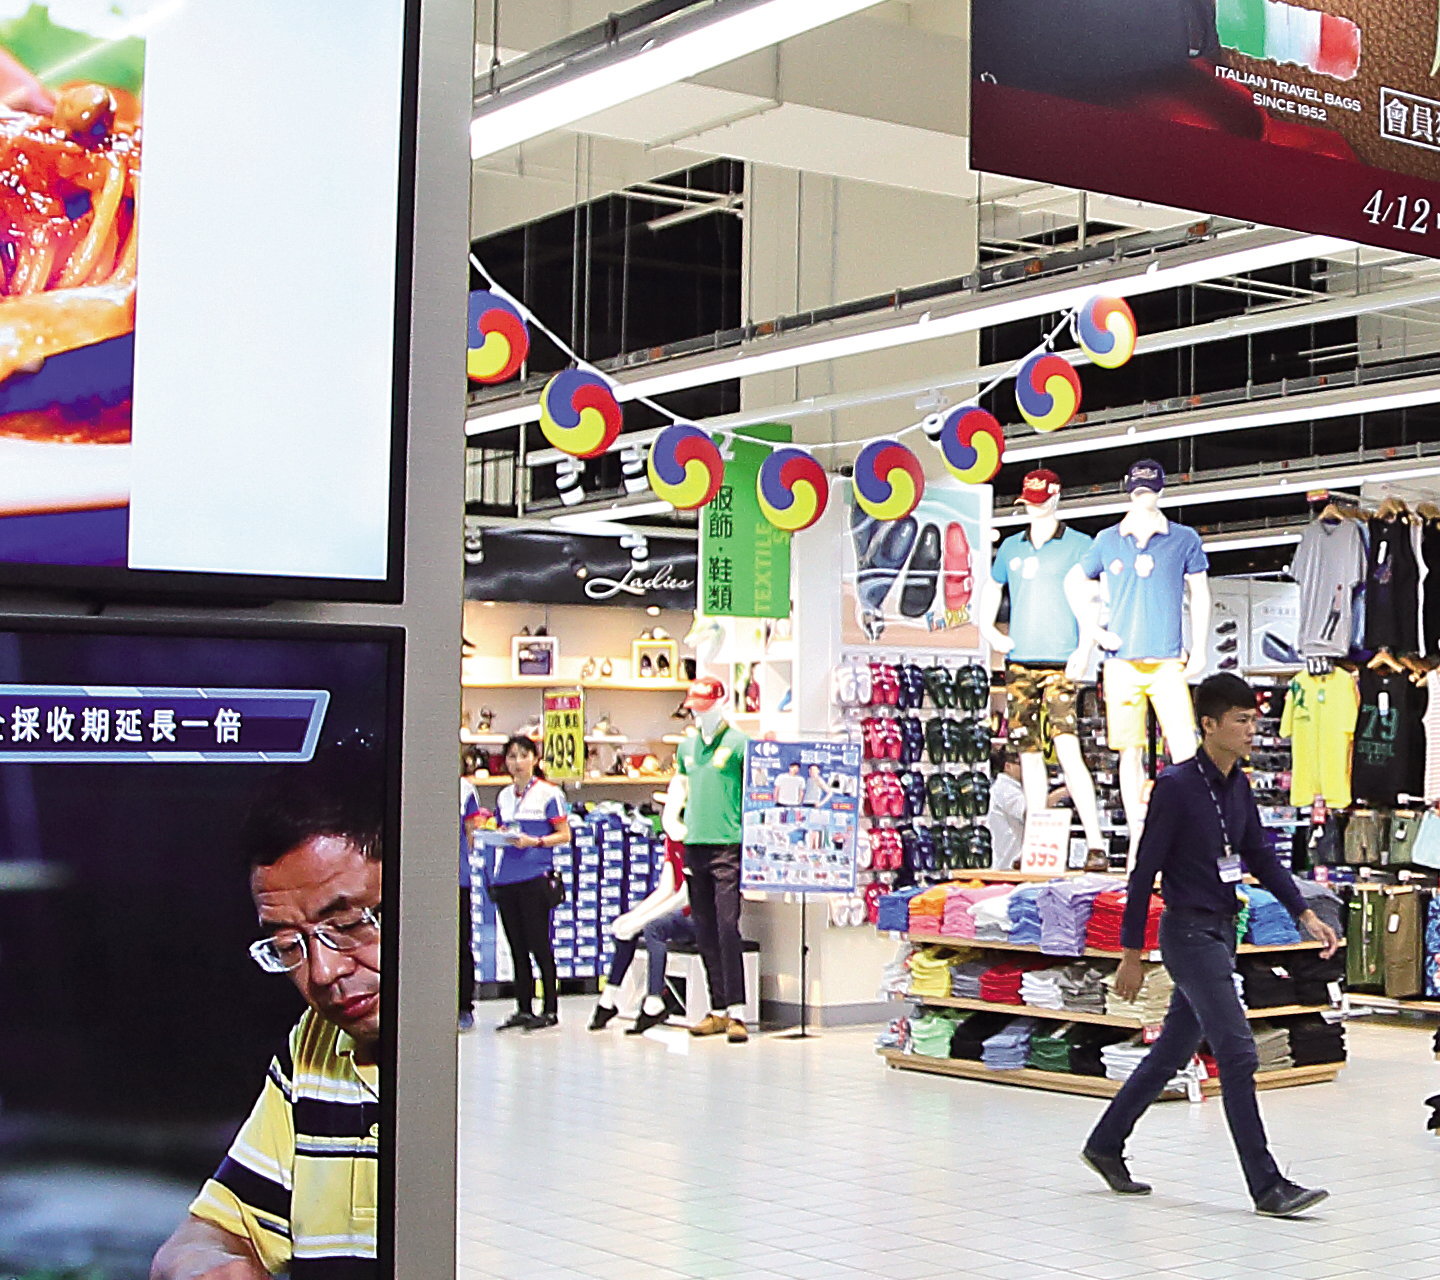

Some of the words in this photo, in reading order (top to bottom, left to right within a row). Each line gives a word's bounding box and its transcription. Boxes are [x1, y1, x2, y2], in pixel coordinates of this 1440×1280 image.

[1215, 65, 1268, 89] ITALIAN
[1271, 78, 1322, 103] TRAVEL
[1324, 92, 1362, 112] BAGS
[1253, 93, 1295, 114] SINCE
[1297, 103, 1328, 122] 1952
[1362, 188, 1431, 235] 4/12
[584, 564, 695, 600] Ladies
[754, 522, 773, 615] TEXTILE
